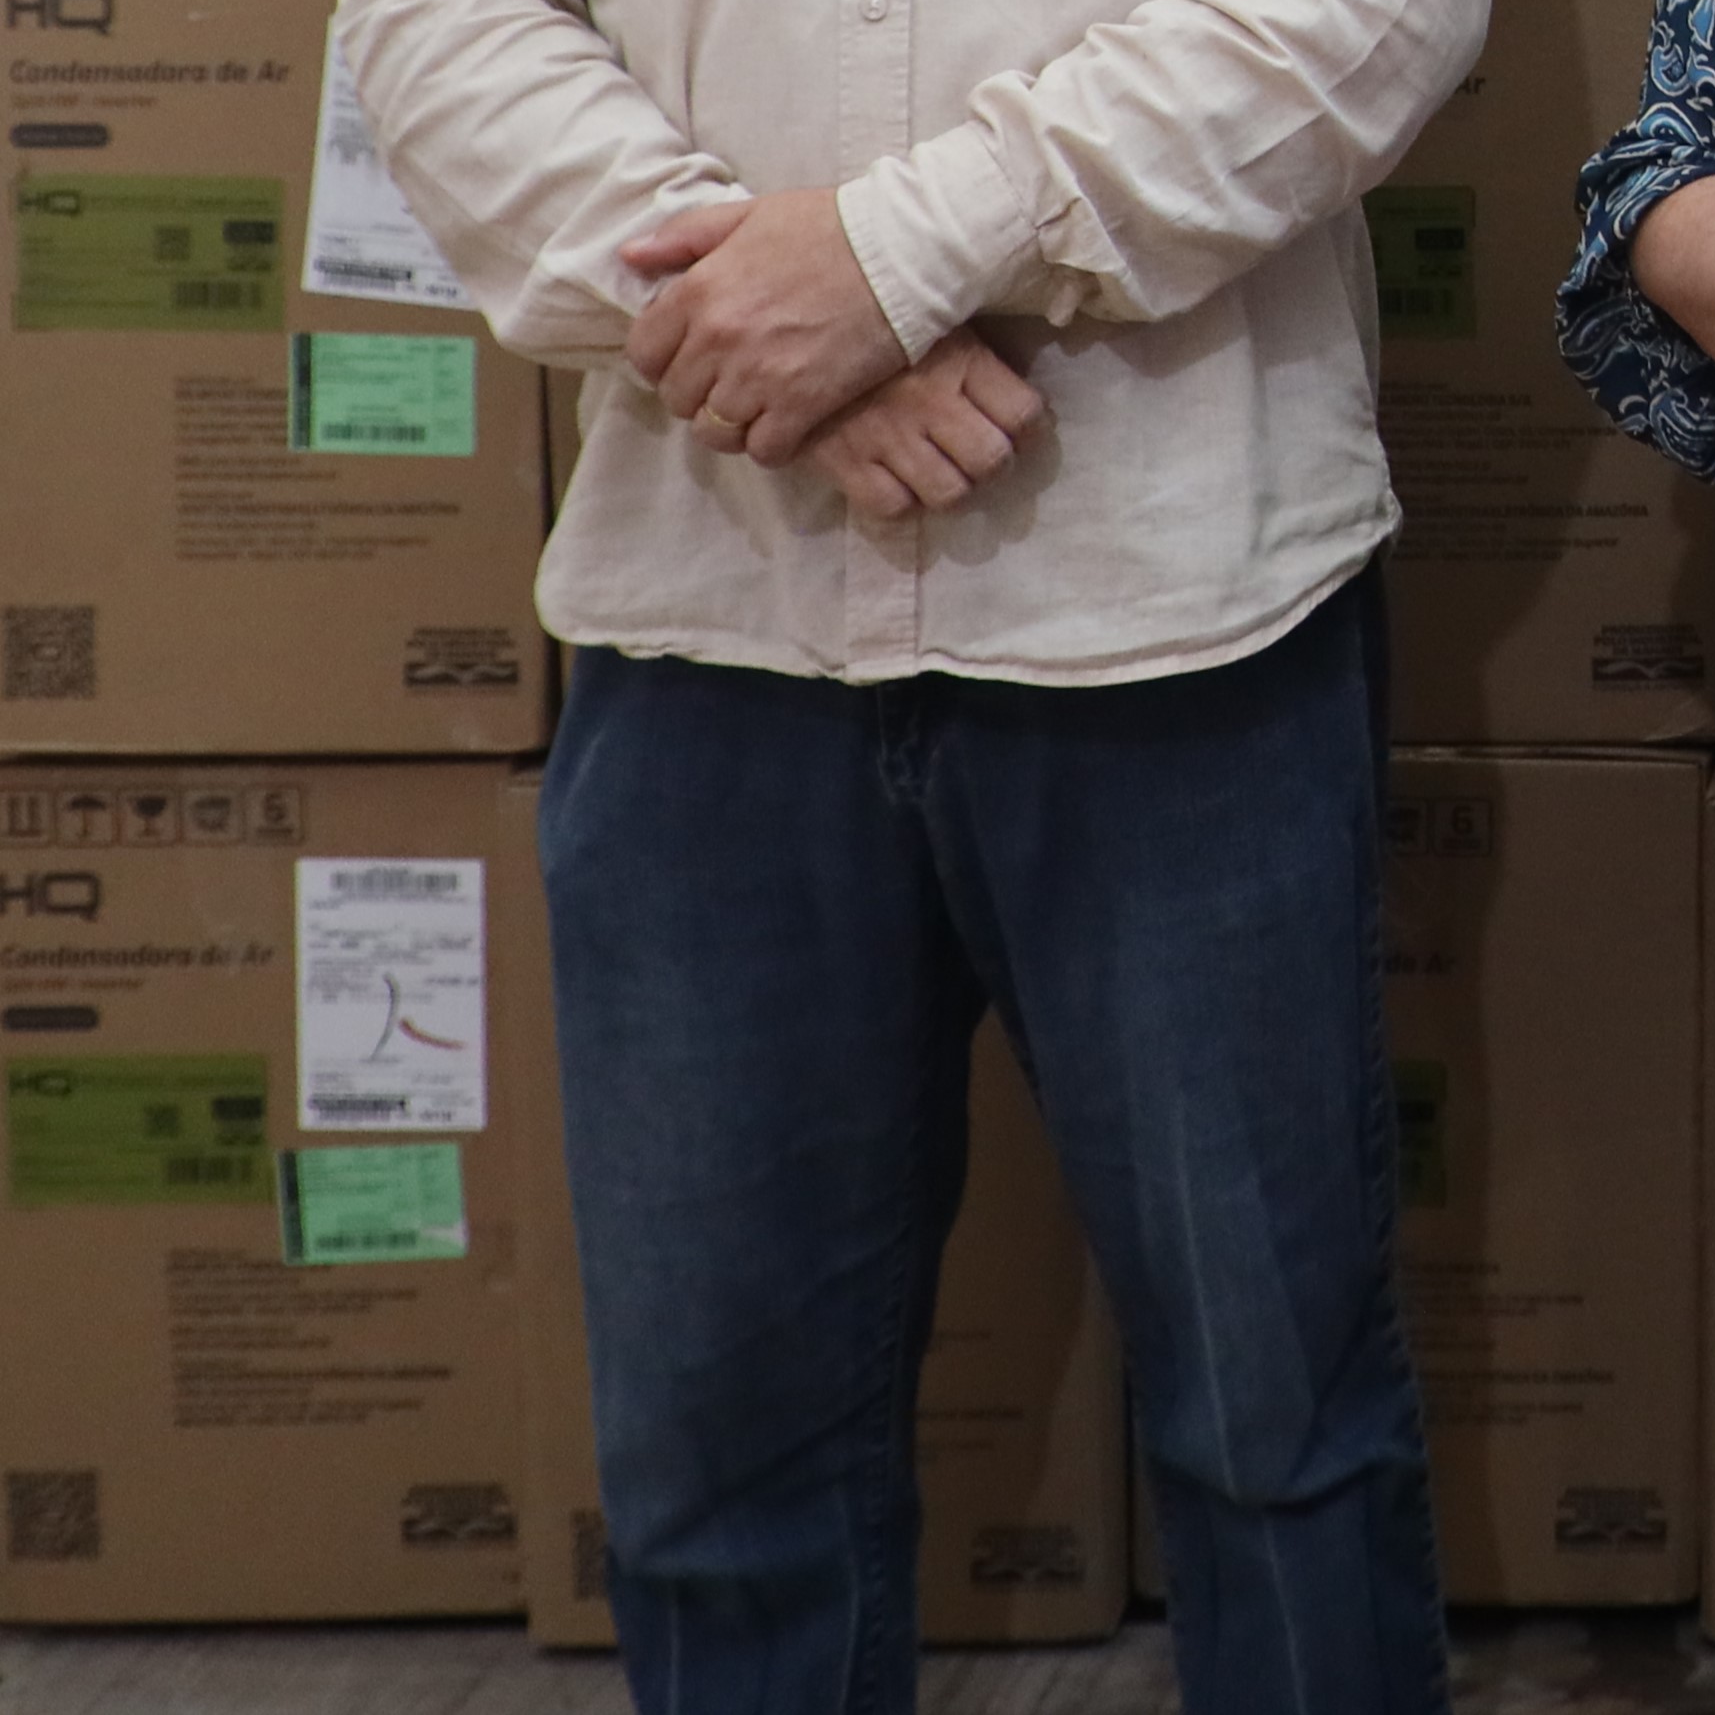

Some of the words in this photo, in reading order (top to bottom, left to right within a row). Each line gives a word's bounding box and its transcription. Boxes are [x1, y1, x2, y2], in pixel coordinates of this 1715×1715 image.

[11, 61, 206, 83] Condensadora
[216, 61, 247, 83] de
[257, 61, 289, 83] Ar
[1451, 804, 1474, 835] 6
[0, 872, 102, 921] HQ
[1, 945, 190, 967] Condensadora
